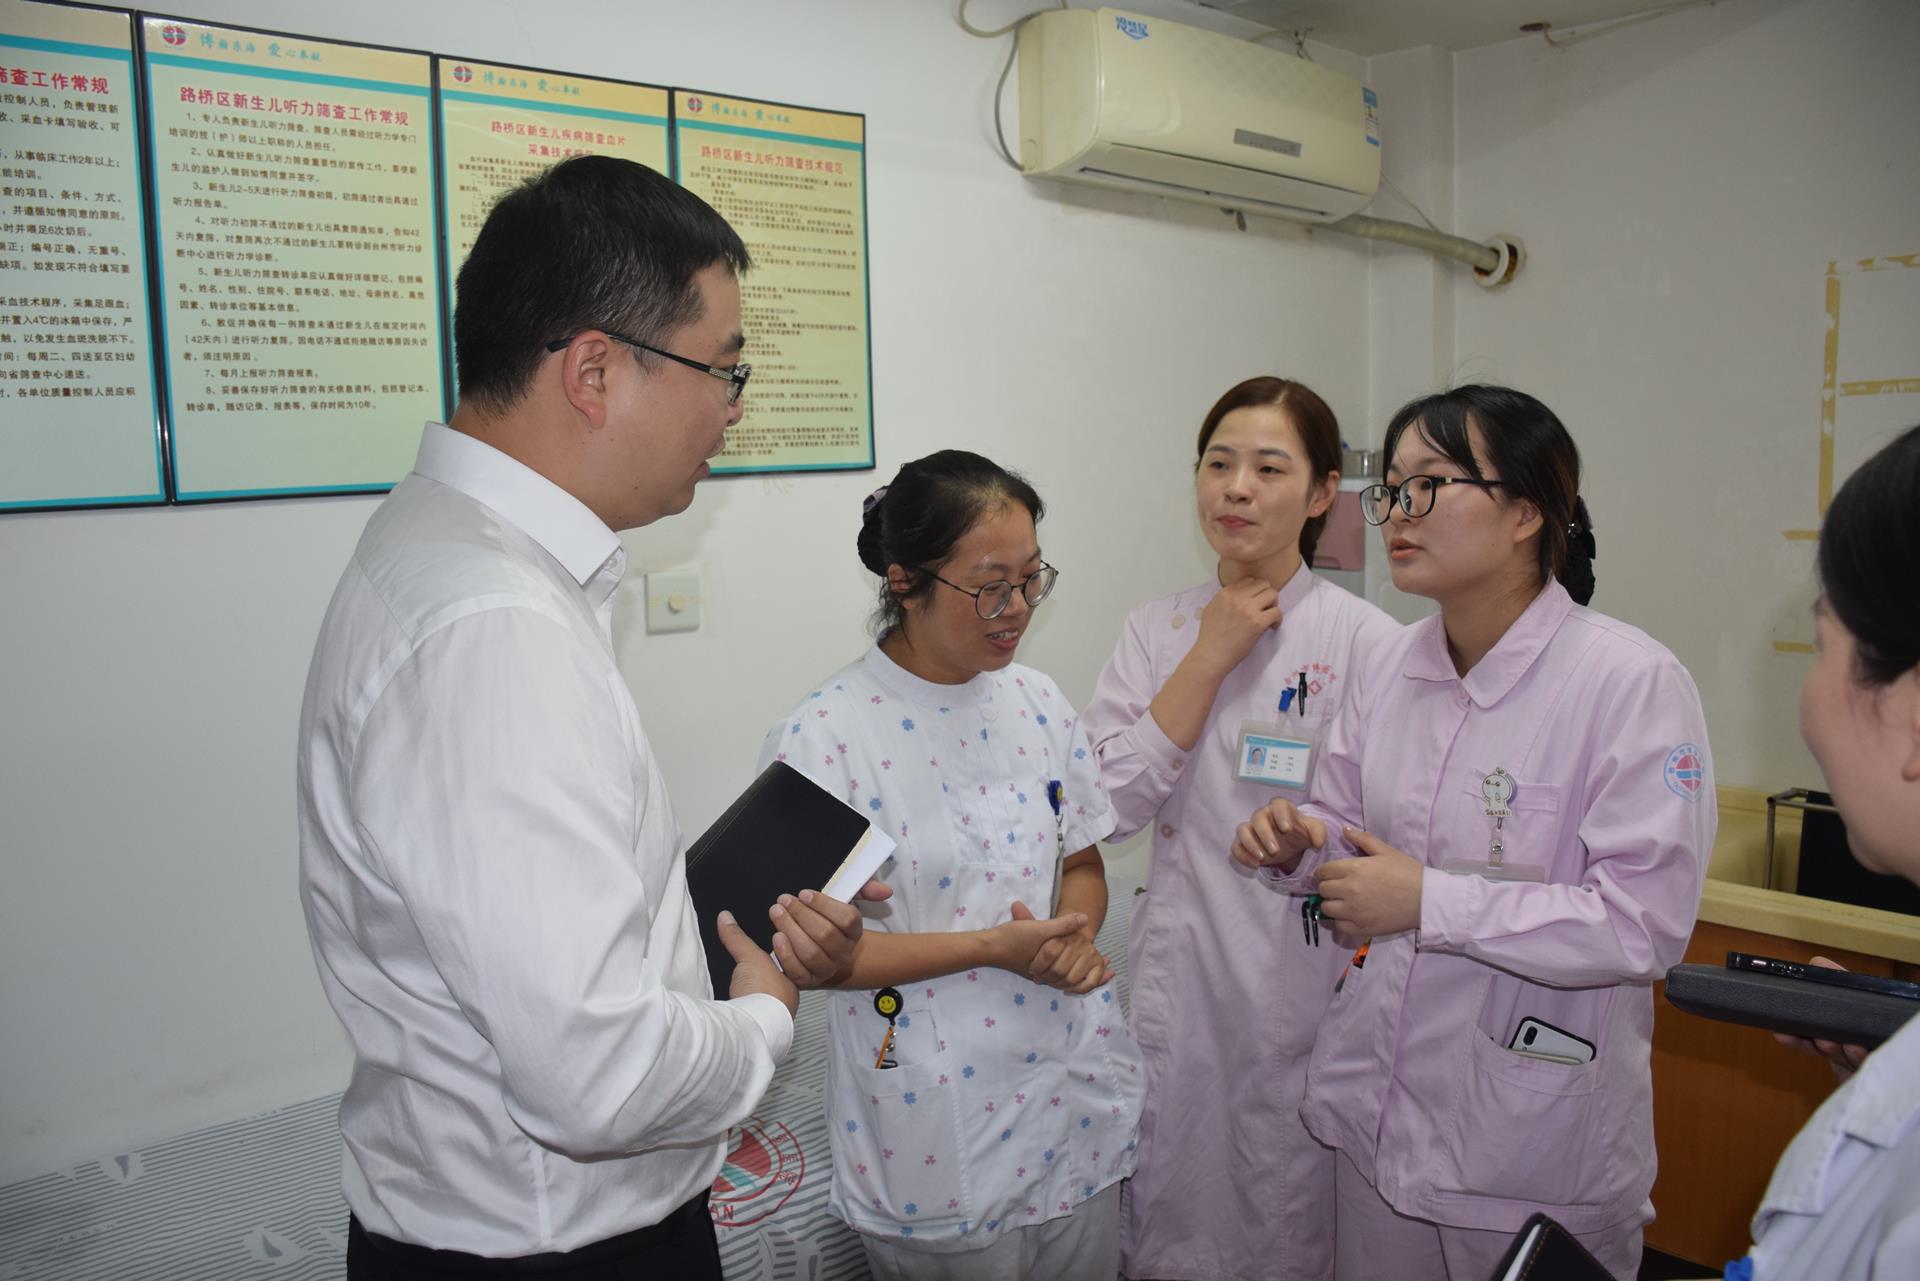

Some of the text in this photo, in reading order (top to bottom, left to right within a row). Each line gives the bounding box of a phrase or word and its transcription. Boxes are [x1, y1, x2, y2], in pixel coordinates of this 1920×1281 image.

[0, 94, 119, 114] 控制人员，负责管理新
[180, 87, 409, 126] 路桥区新生儿听力筛查工作常规
[0, 168, 42, 180] 能培训。
